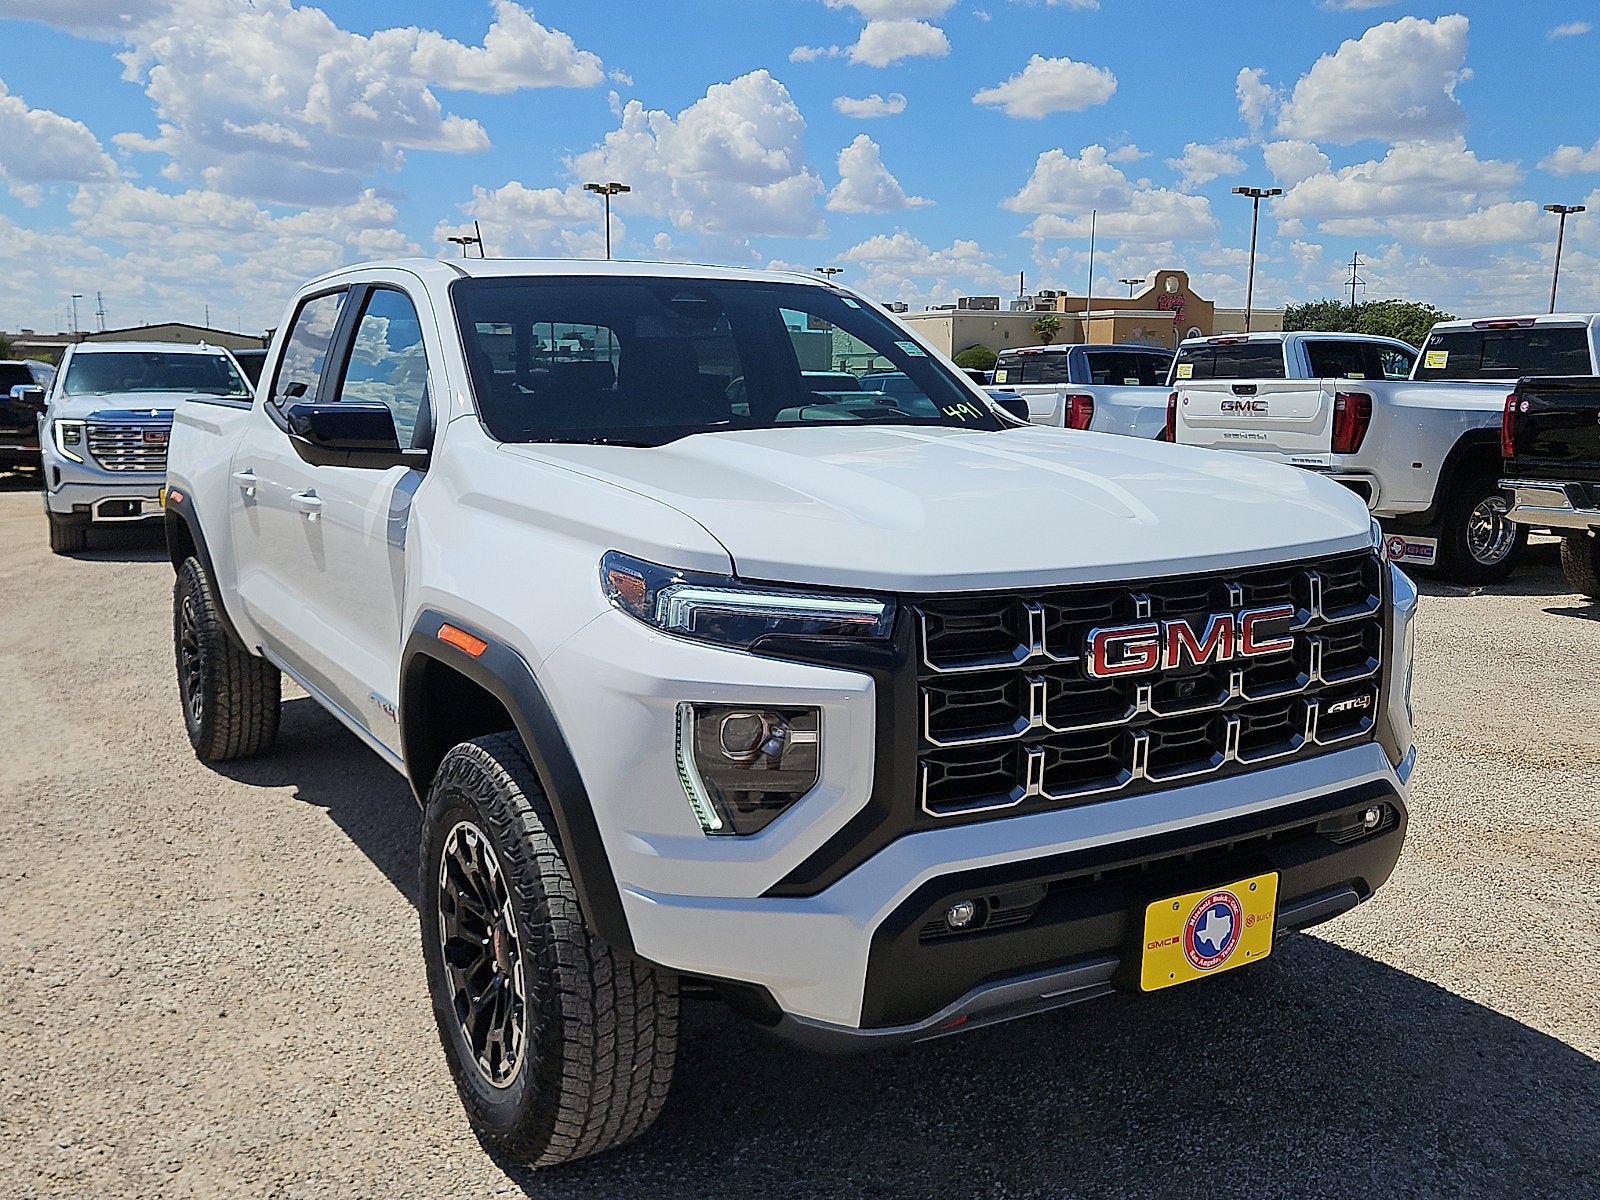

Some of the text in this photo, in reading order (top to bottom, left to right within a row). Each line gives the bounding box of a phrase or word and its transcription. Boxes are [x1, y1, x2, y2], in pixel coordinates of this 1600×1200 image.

[942, 401, 984, 422] 491
[1220, 400, 1269, 412] GMC
[1086, 604, 1295, 679] GMC
[1327, 695, 1371, 714] AT4
[1256, 911, 1273, 923] BUICK
[1147, 937, 1172, 950] GMC
